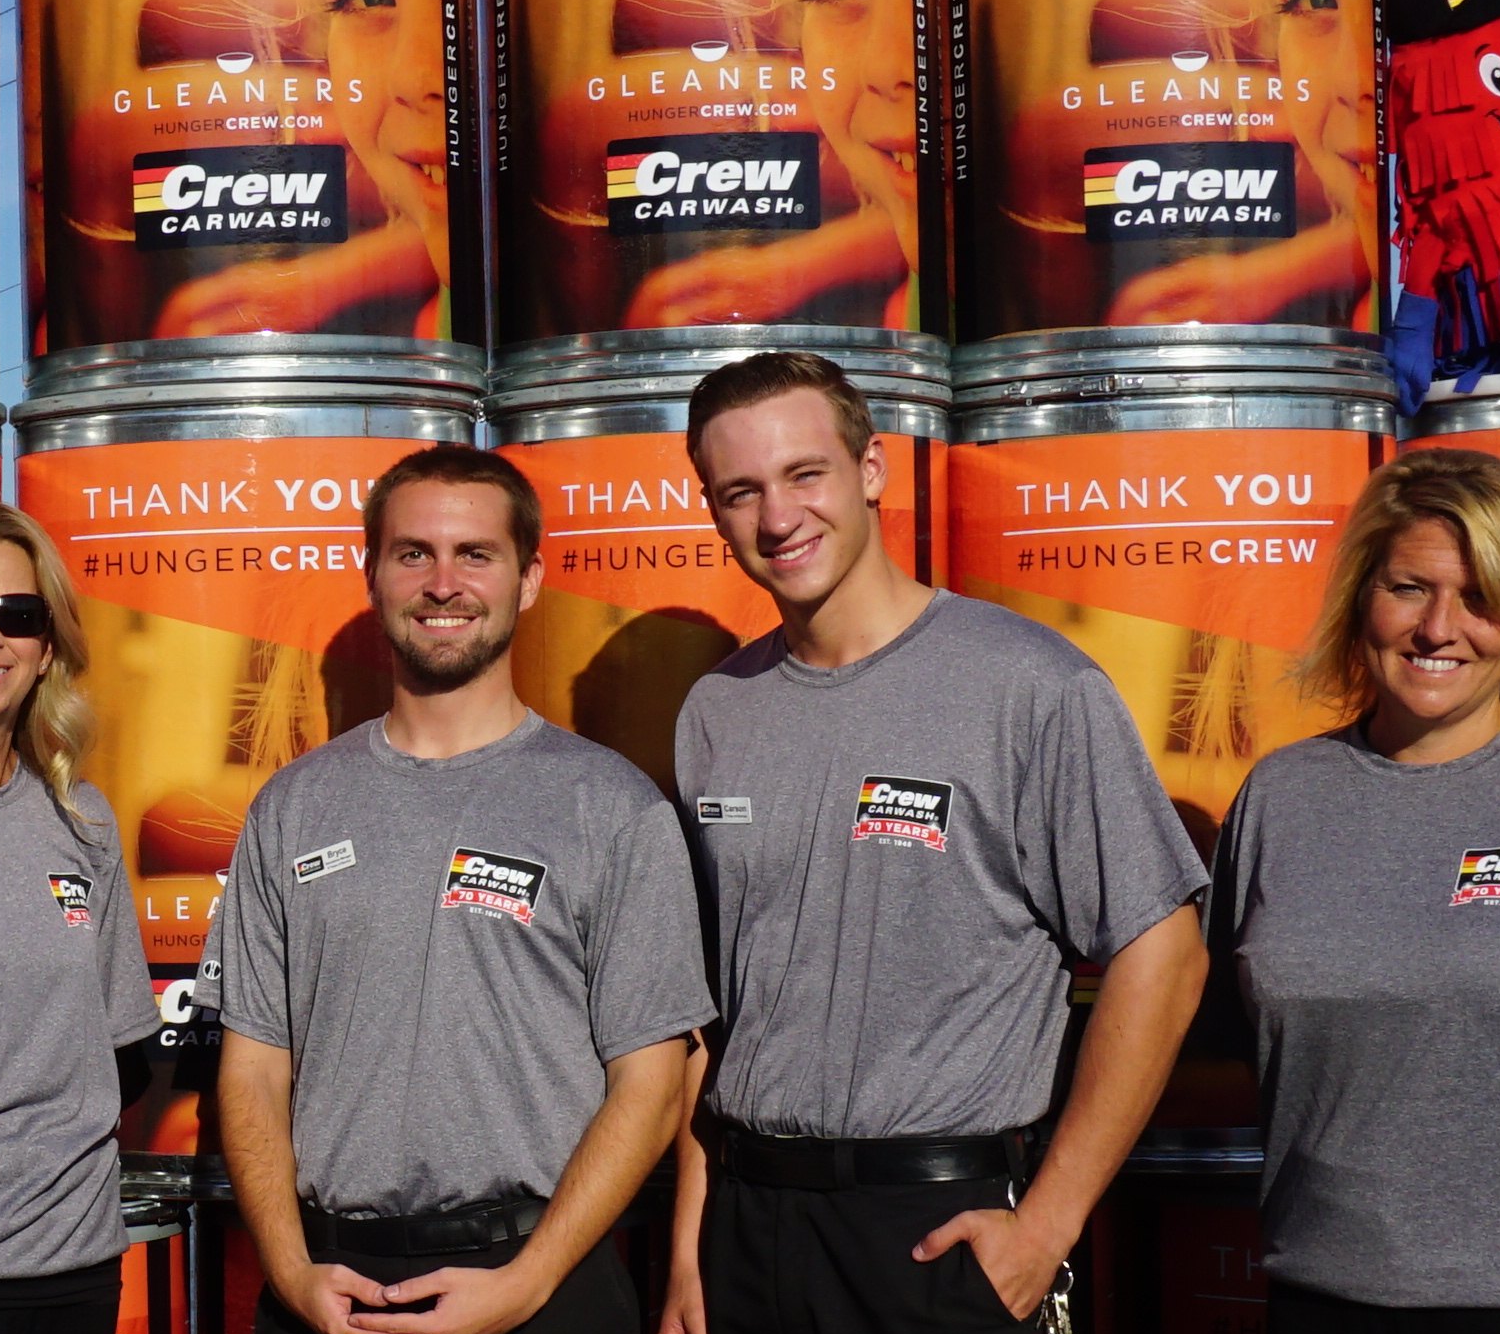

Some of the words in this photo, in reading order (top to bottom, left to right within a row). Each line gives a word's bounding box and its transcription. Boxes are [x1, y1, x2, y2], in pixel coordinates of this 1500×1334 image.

[114, 78, 363, 113] GLEANERS
[588, 68, 836, 102] GLEANERS
[1062, 77, 1310, 110] GLEANERS
[153, 114, 323, 134] HUNGERCREW.COM
[628, 103, 797, 123] HUNGERCREW.COM
[1106, 112, 1274, 130] HUNGERCREW.COM
[161, 164, 328, 209] Crew
[635, 151, 801, 195] Crew
[1114, 160, 1278, 203] Crew
[83, 481, 249, 519] THANK
[561, 477, 707, 515] THAN
[1016, 475, 1187, 515] THANK
[1214, 474, 1313, 507] YOU
[562, 543, 735, 573] #HUNGER
[1019, 538, 1317, 571] #HUNGERCREW
[872, 783, 941, 810] Crew
[867, 822, 881, 831] 70
[886, 823, 929, 838] YEARS
[327, 848, 347, 858] Bryce
[464, 857, 534, 886] Crew
[459, 891, 473, 900] 70
[478, 893, 520, 912] YEARS
